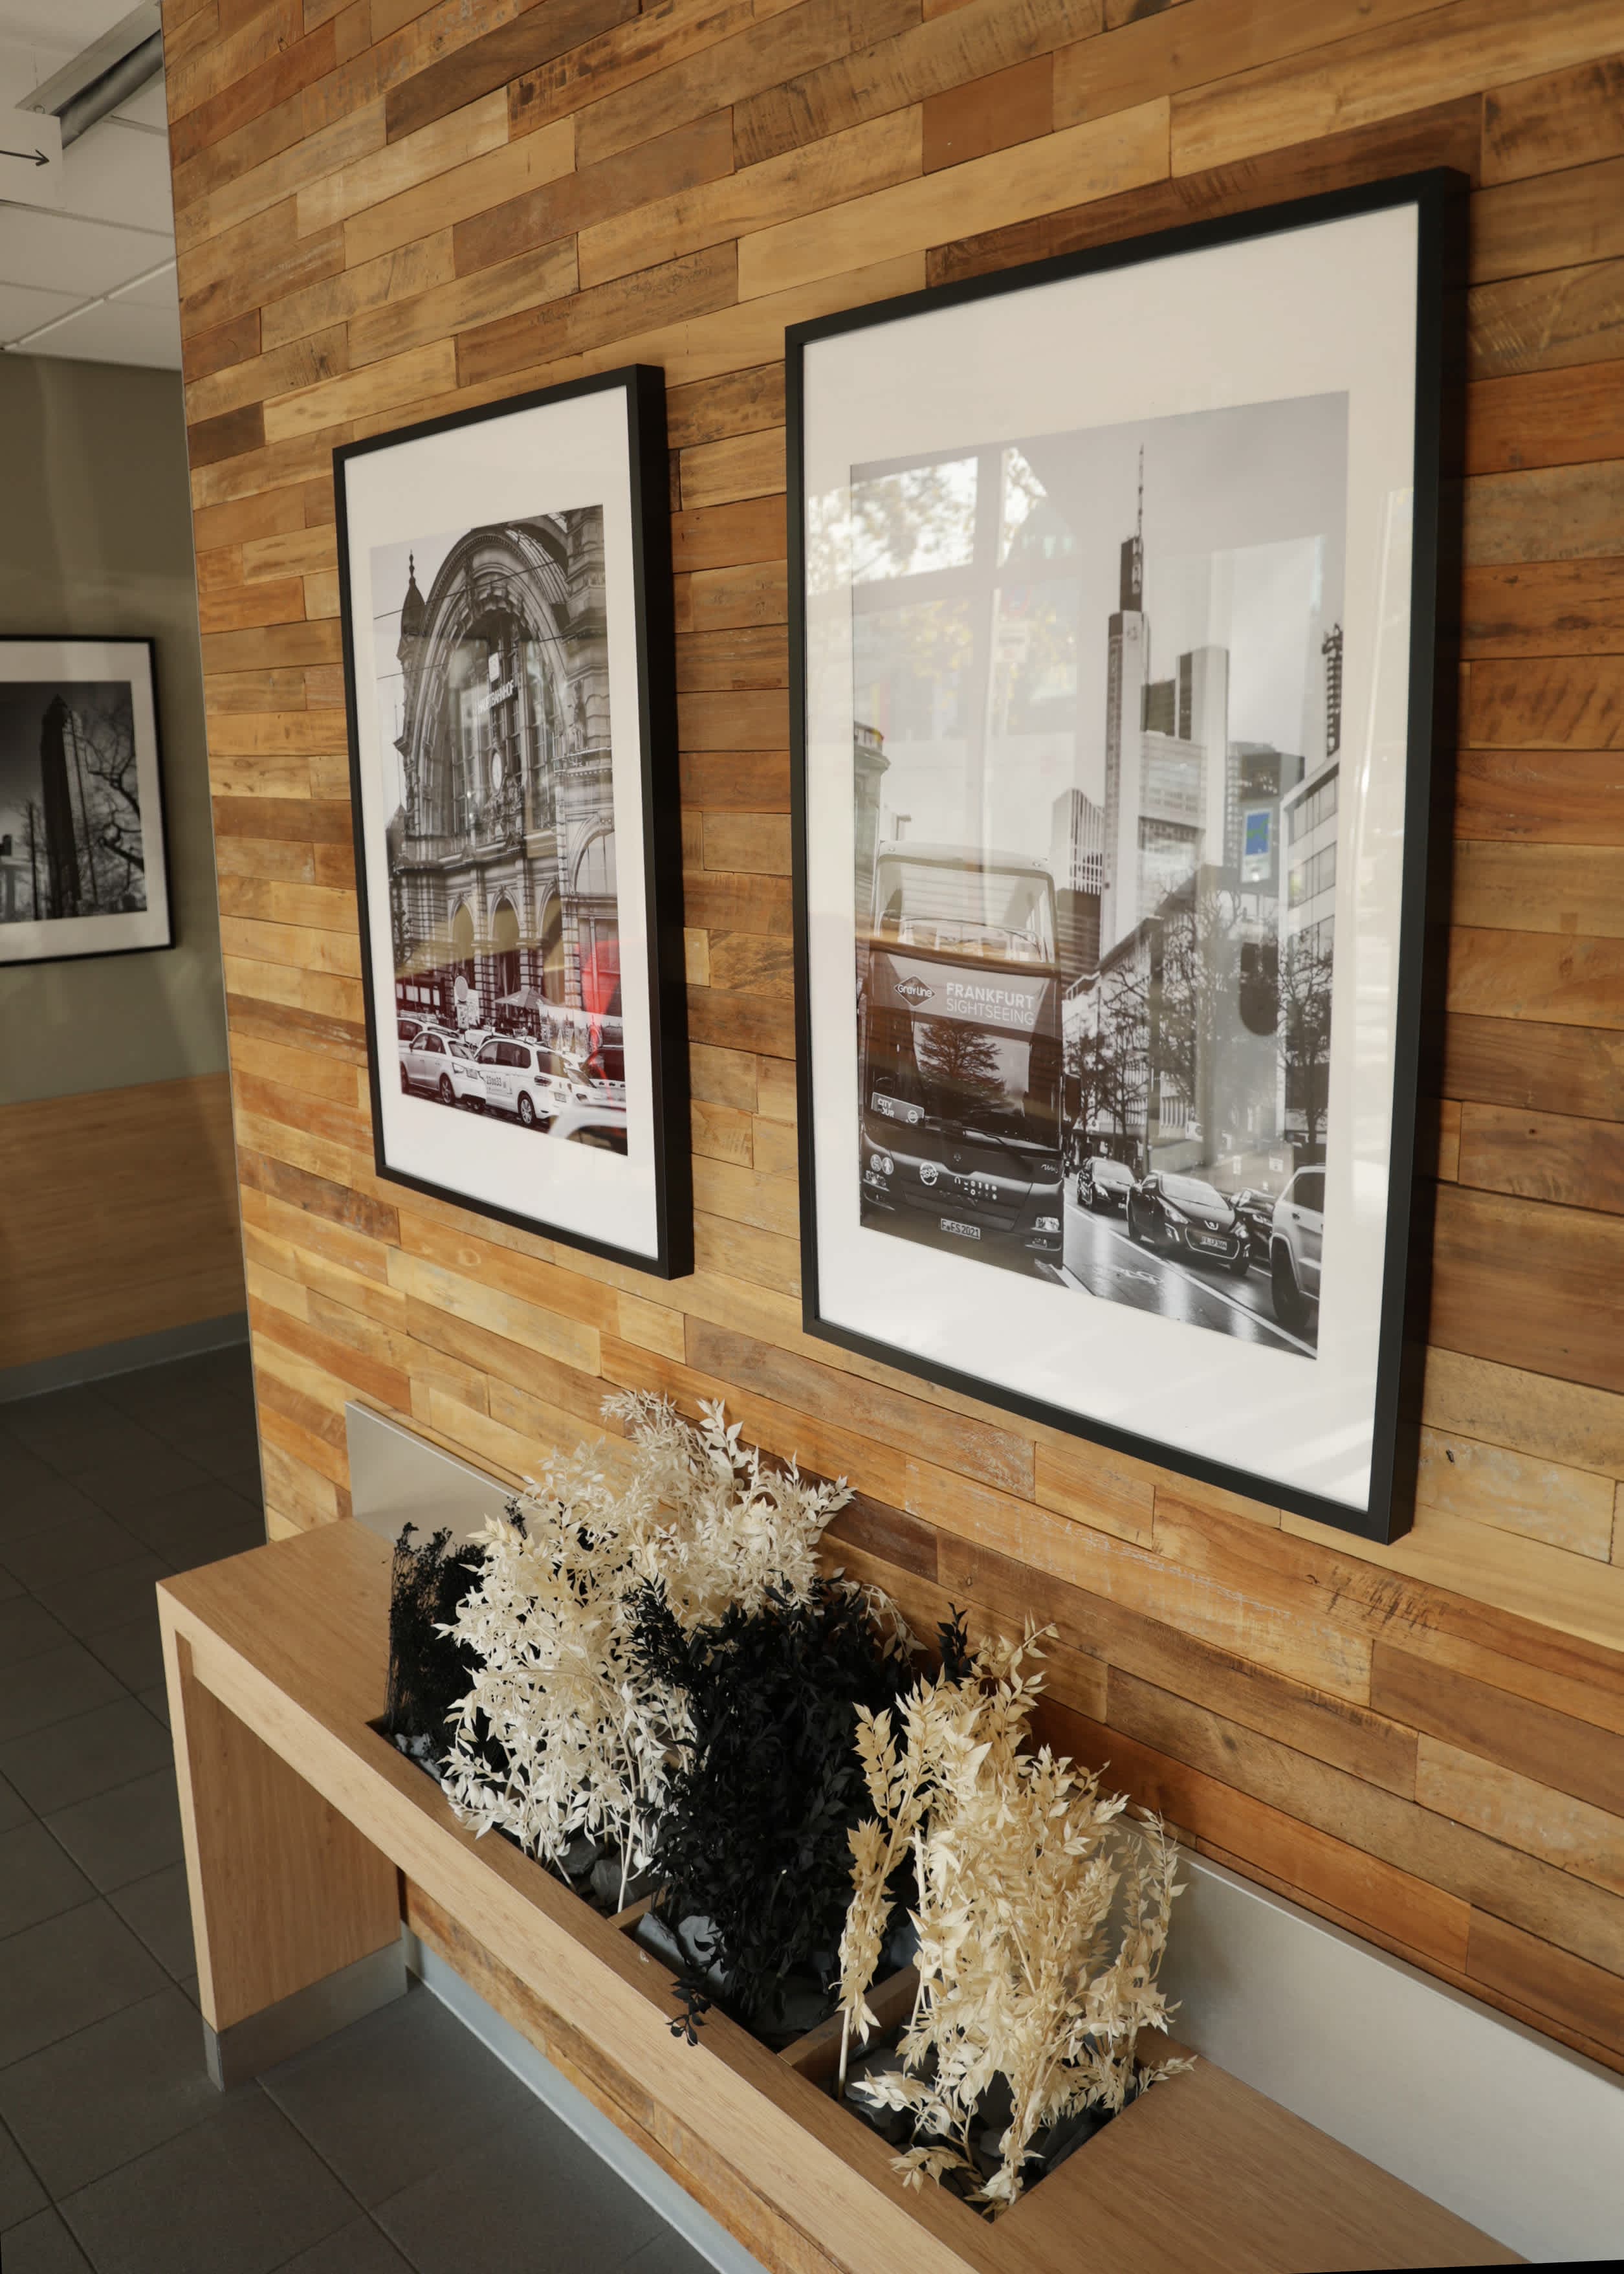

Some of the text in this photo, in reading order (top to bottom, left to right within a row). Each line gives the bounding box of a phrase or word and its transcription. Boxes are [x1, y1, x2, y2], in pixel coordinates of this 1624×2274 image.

[947, 982, 1035, 1010] FRANKFURT
[947, 998, 1035, 1026] SIGHTSEEING
[877, 1098, 892, 1109] CITY
